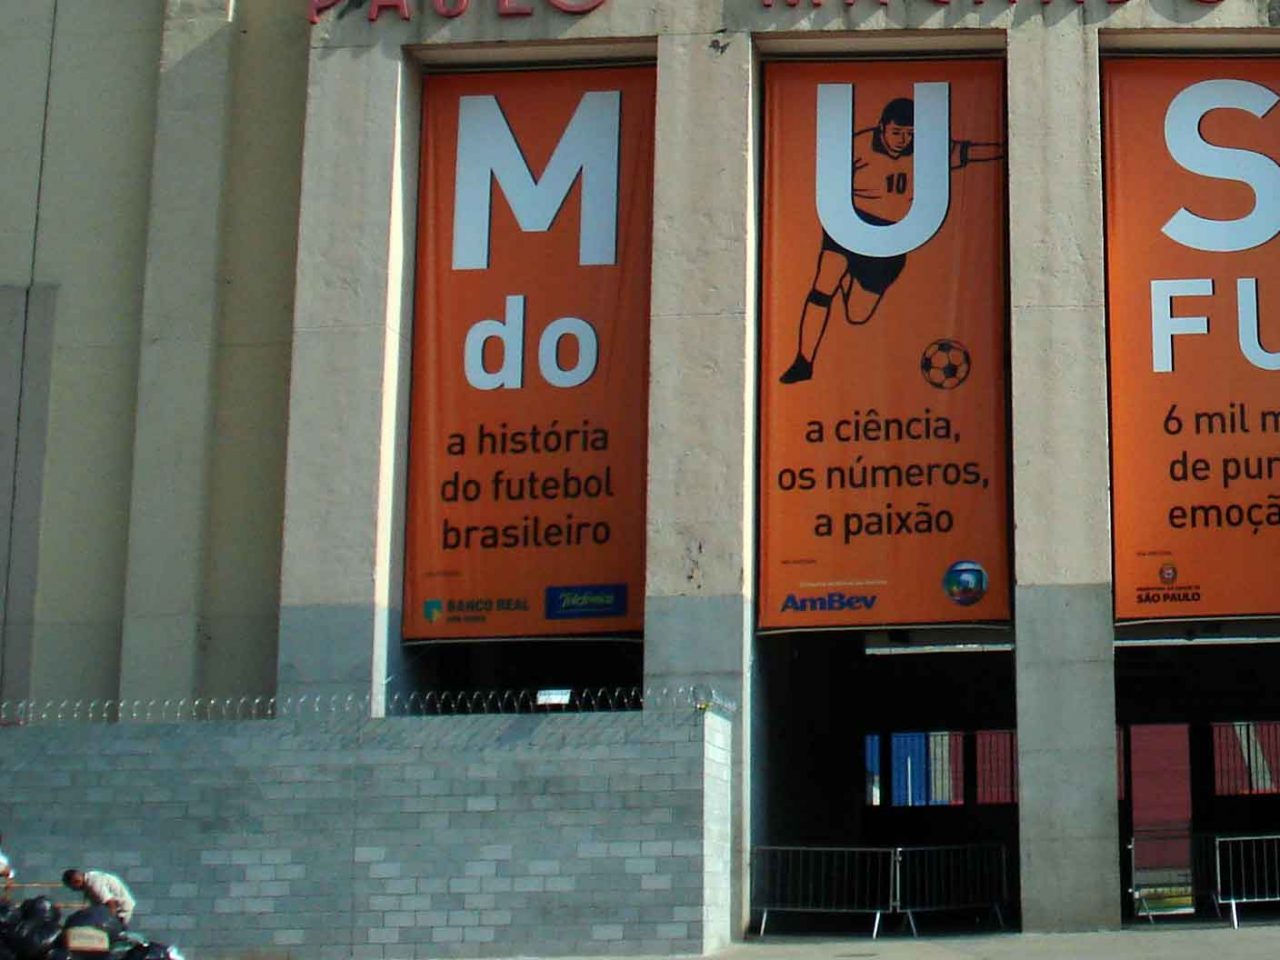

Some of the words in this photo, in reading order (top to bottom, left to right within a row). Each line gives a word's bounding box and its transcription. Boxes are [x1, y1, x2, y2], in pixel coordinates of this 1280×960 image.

[452, 90, 621, 270] M
[816, 81, 951, 258] U
[885, 172, 908, 195] 10
[463, 294, 599, 391] do
[805, 419, 824, 443] a
[834, 408, 961, 444] ciência,
[1163, 404, 1183, 436] 6
[1194, 402, 1250, 435] mil
[446, 433, 466, 456] a
[478, 420, 609, 455] história
[778, 467, 816, 492] os
[827, 455, 989, 490] números,
[1169, 450, 1211, 482] de
[440, 471, 481, 503] do
[491, 466, 614, 502] futebol
[442, 514, 612, 551] brasileiro
[814, 512, 833, 537] a
[844, 502, 955, 545] paixão
[780, 591, 878, 612] AmBev
[1162, 591, 1201, 603] PAULO
